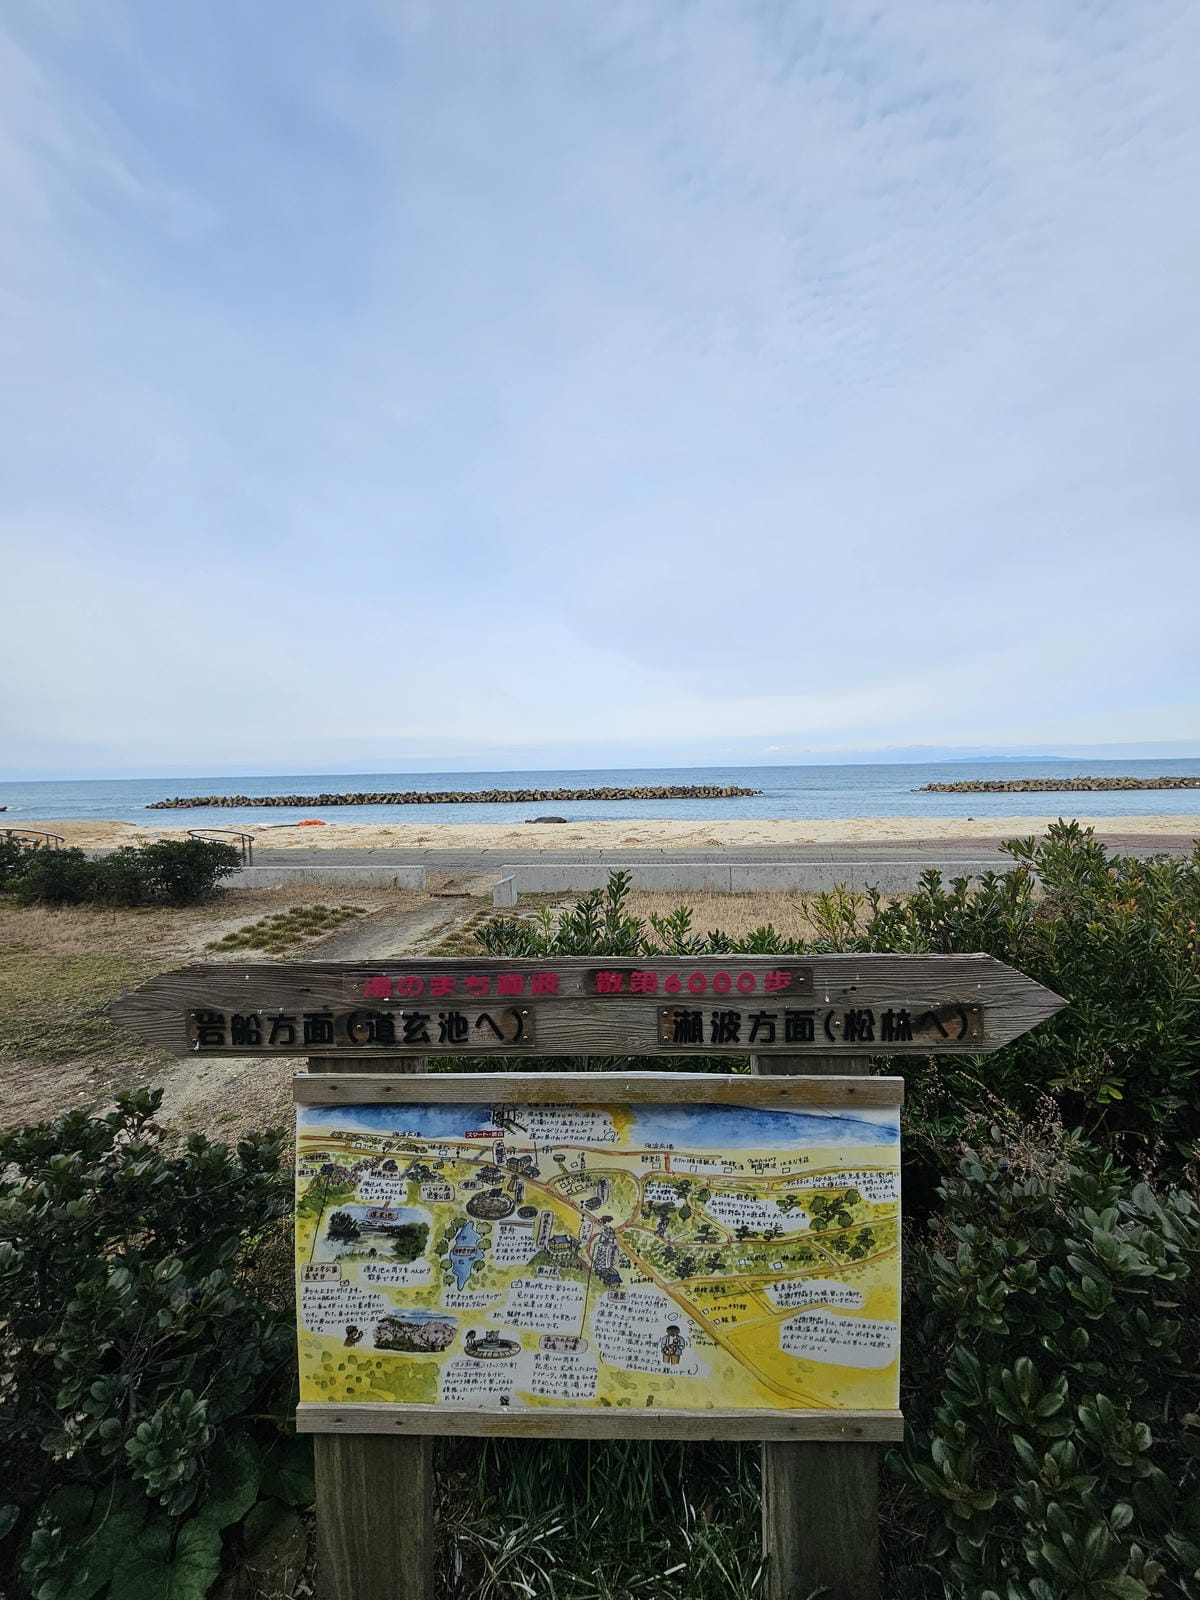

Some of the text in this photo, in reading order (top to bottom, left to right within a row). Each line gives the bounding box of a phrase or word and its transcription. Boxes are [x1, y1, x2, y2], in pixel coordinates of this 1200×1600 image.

[596, 970, 792, 993] 散策6000歩
[196, 1011, 524, 1046] 岩船方面(道玄池へ)
[673, 1007, 968, 1043] 瀬波方面(松林へ)
